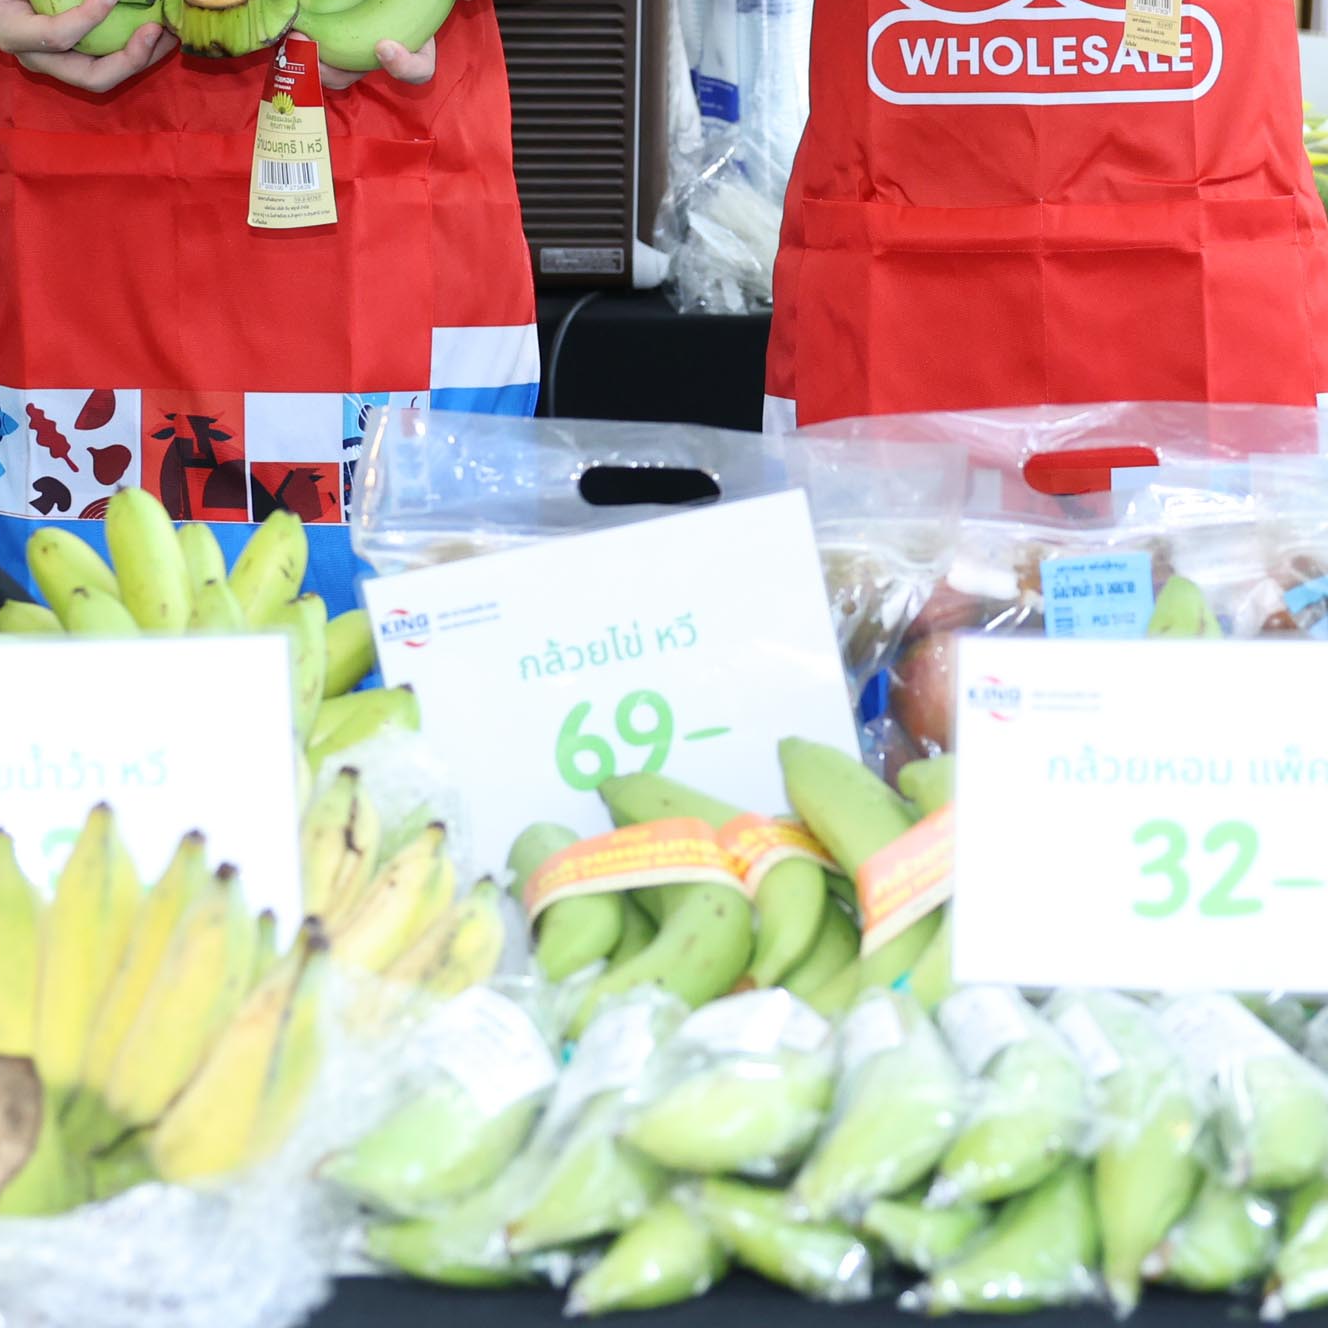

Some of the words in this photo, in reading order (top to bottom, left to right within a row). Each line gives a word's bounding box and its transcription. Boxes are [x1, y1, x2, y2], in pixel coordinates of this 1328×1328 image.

[898, 33, 1194, 76] WHOLESALE
[307, 138, 322, 154] หวี
[518, 620, 644, 680] กล้วยไข่
[656, 612, 698, 653] หวี
[120, 748, 169, 787] หวี
[1046, 744, 1233, 786] กล้วยหอม
